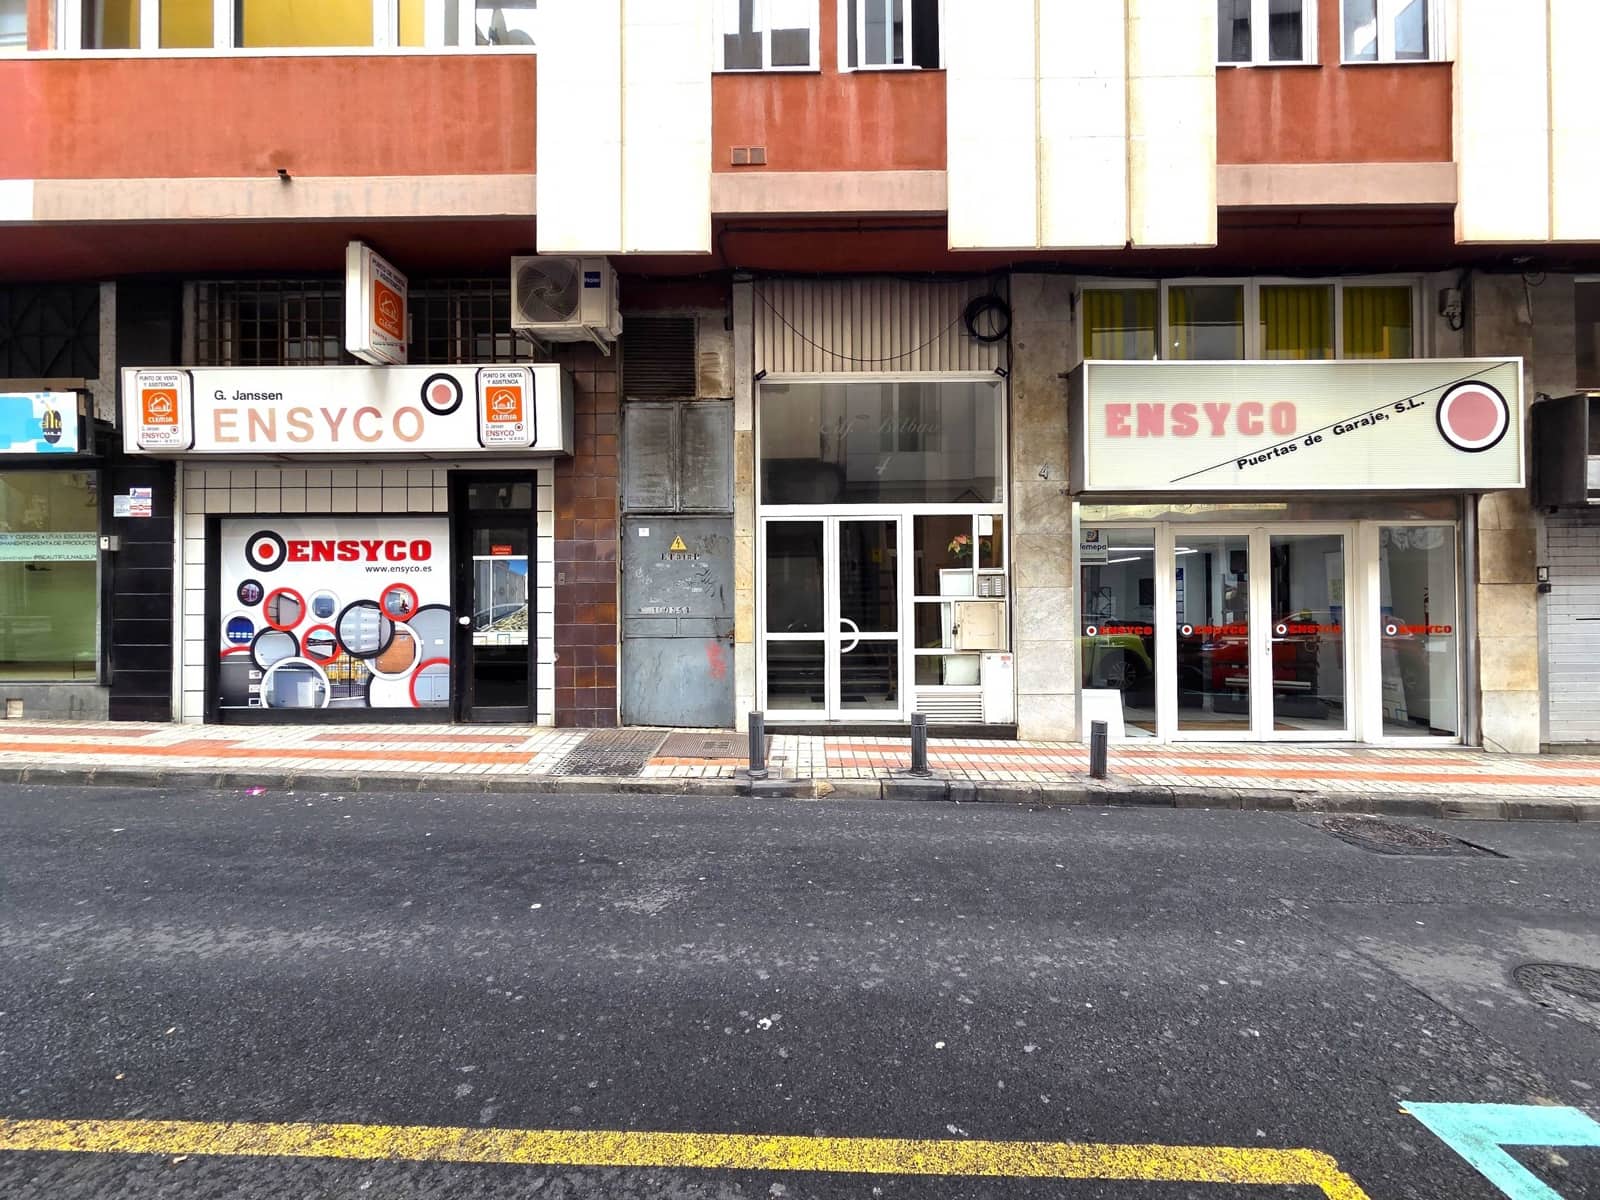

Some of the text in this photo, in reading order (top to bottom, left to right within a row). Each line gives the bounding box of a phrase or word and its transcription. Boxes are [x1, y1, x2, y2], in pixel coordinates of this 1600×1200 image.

[214, 390, 283, 401] G. Janssen
[213, 406, 425, 443] ENSYCO
[1104, 401, 1297, 438] ENSYCO
[1236, 398, 1425, 470] Puertas de Garaje, S.L.
[1039, 462, 1048, 480] 4
[287, 540, 432, 562] ENSYCO
[365, 564, 433, 574] www.ensyco.es
[1100, 626, 1153, 635] ENSYCO
